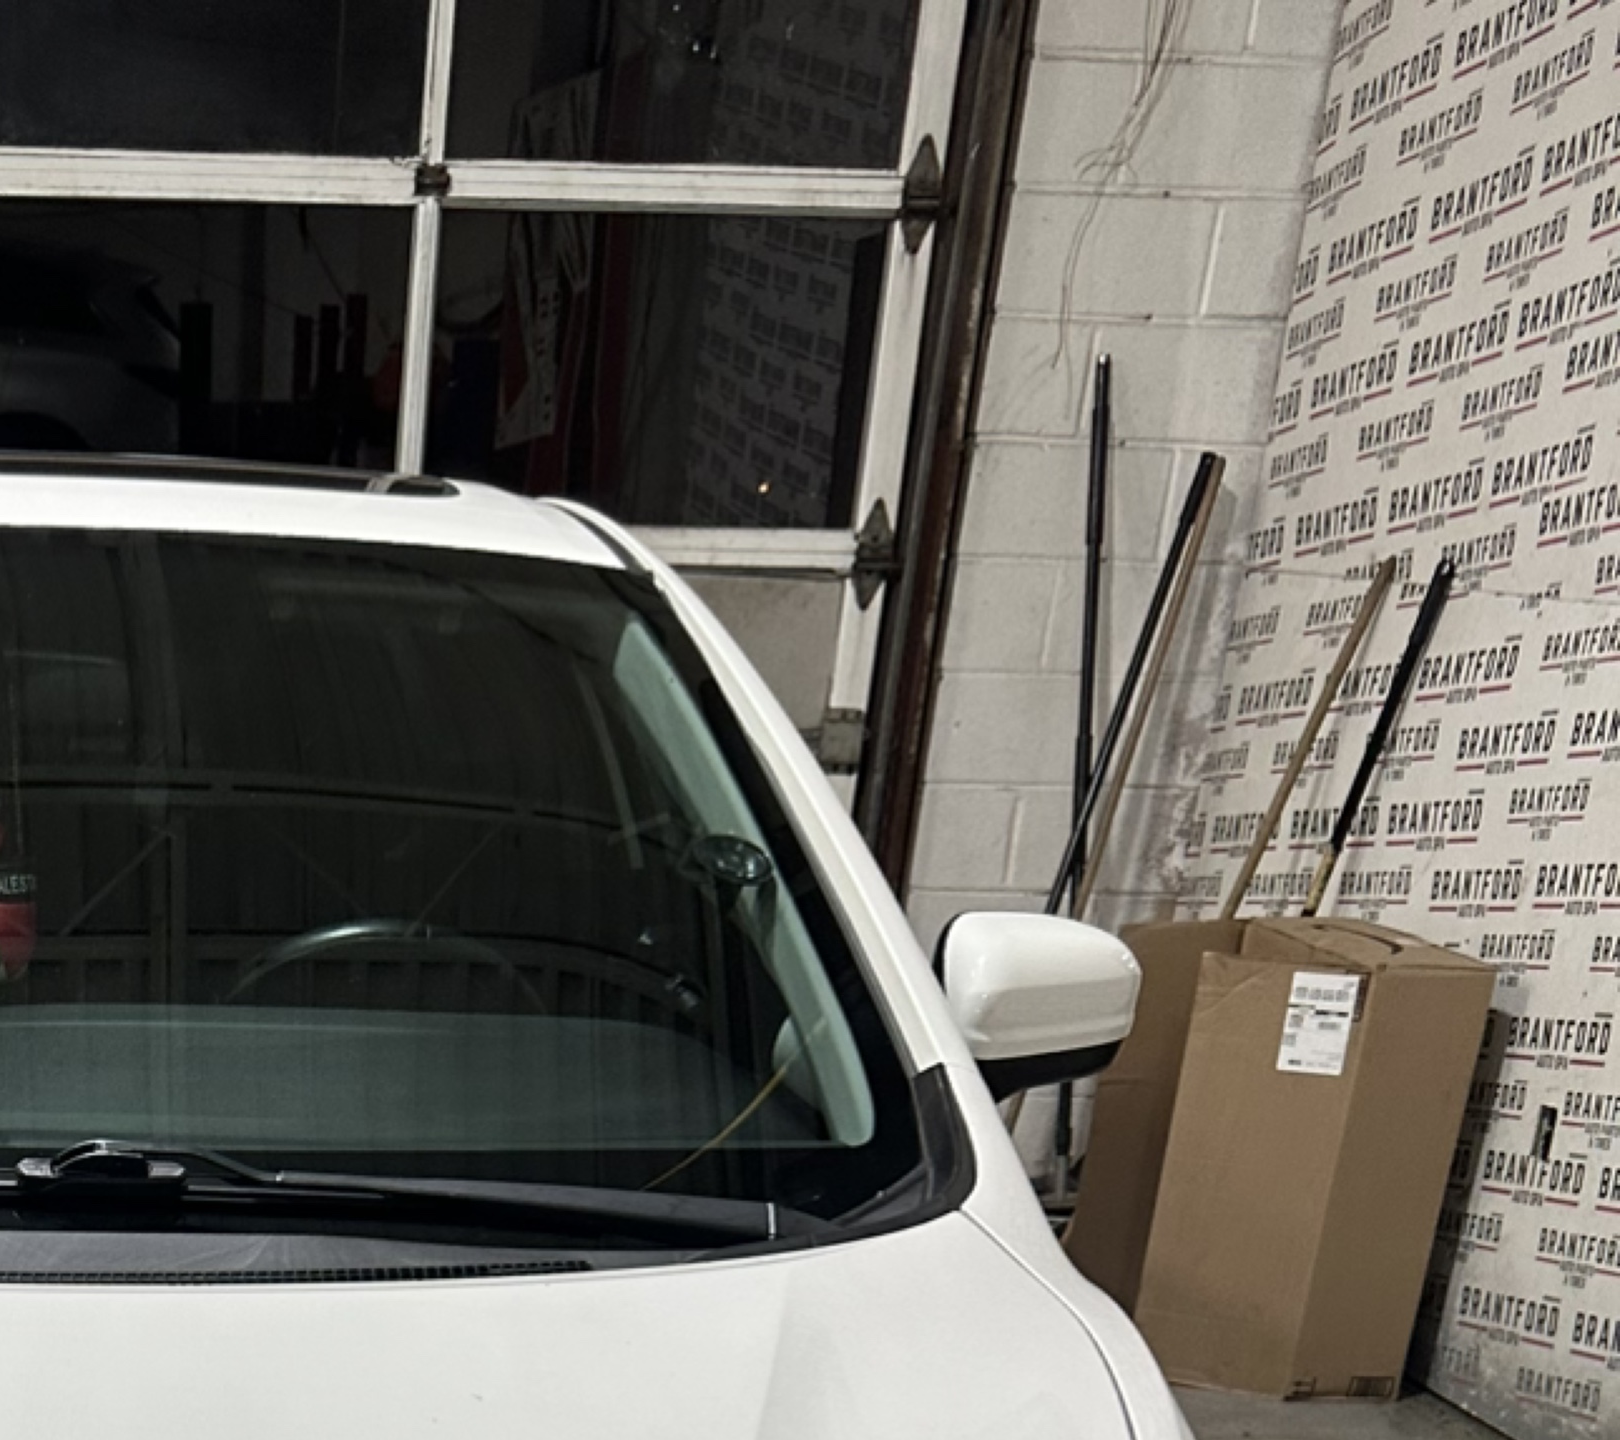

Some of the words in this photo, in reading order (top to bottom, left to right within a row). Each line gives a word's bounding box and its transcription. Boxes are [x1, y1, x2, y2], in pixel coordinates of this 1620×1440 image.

[1350, 43, 1442, 121] BRANTFORD
[1512, 35, 1593, 104] BRANTFORD
[1399, 95, 1482, 156] BRANTFORD
[1431, 155, 1533, 231] BRANTFORD
[1328, 206, 1418, 273] BRANTFORD
[1485, 213, 1568, 272] BRANTFORD
[1376, 260, 1457, 313] BRANTFORD
[1408, 311, 1509, 375] BRANTFORD
[1310, 350, 1397, 408] BRANTFORD
[1462, 370, 1542, 421] BRANTFORD
[1358, 406, 1432, 451] BRANTFORD
[1491, 435, 1593, 495] BRANTFORD
[1388, 467, 1483, 523] BRANTFORD
[1295, 496, 1377, 546] BRANTFORD
[1542, 624, 1620, 661] BRANTFOR
[1418, 645, 1520, 690] BRANTFORD
[1238, 675, 1314, 715] BRANTFORD
[1457, 718, 1556, 760] BRANTFORD
[1387, 798, 1482, 835] BRANTFORD
[1509, 785, 1590, 814] BRANTFORD
[1339, 871, 1412, 895] BRANTFORD
[1431, 868, 1523, 900] BRANTFORD
[1535, 863, 1620, 897] BRANTFO
[1481, 934, 1555, 960] BRANTFORD
[1507, 1016, 1612, 1055] BRANTFORD
[1483, 1150, 1585, 1194] BRANTFORD
[1458, 1285, 1560, 1337] BRANTFORD
[1516, 1366, 1601, 1412] BRANTFORD
